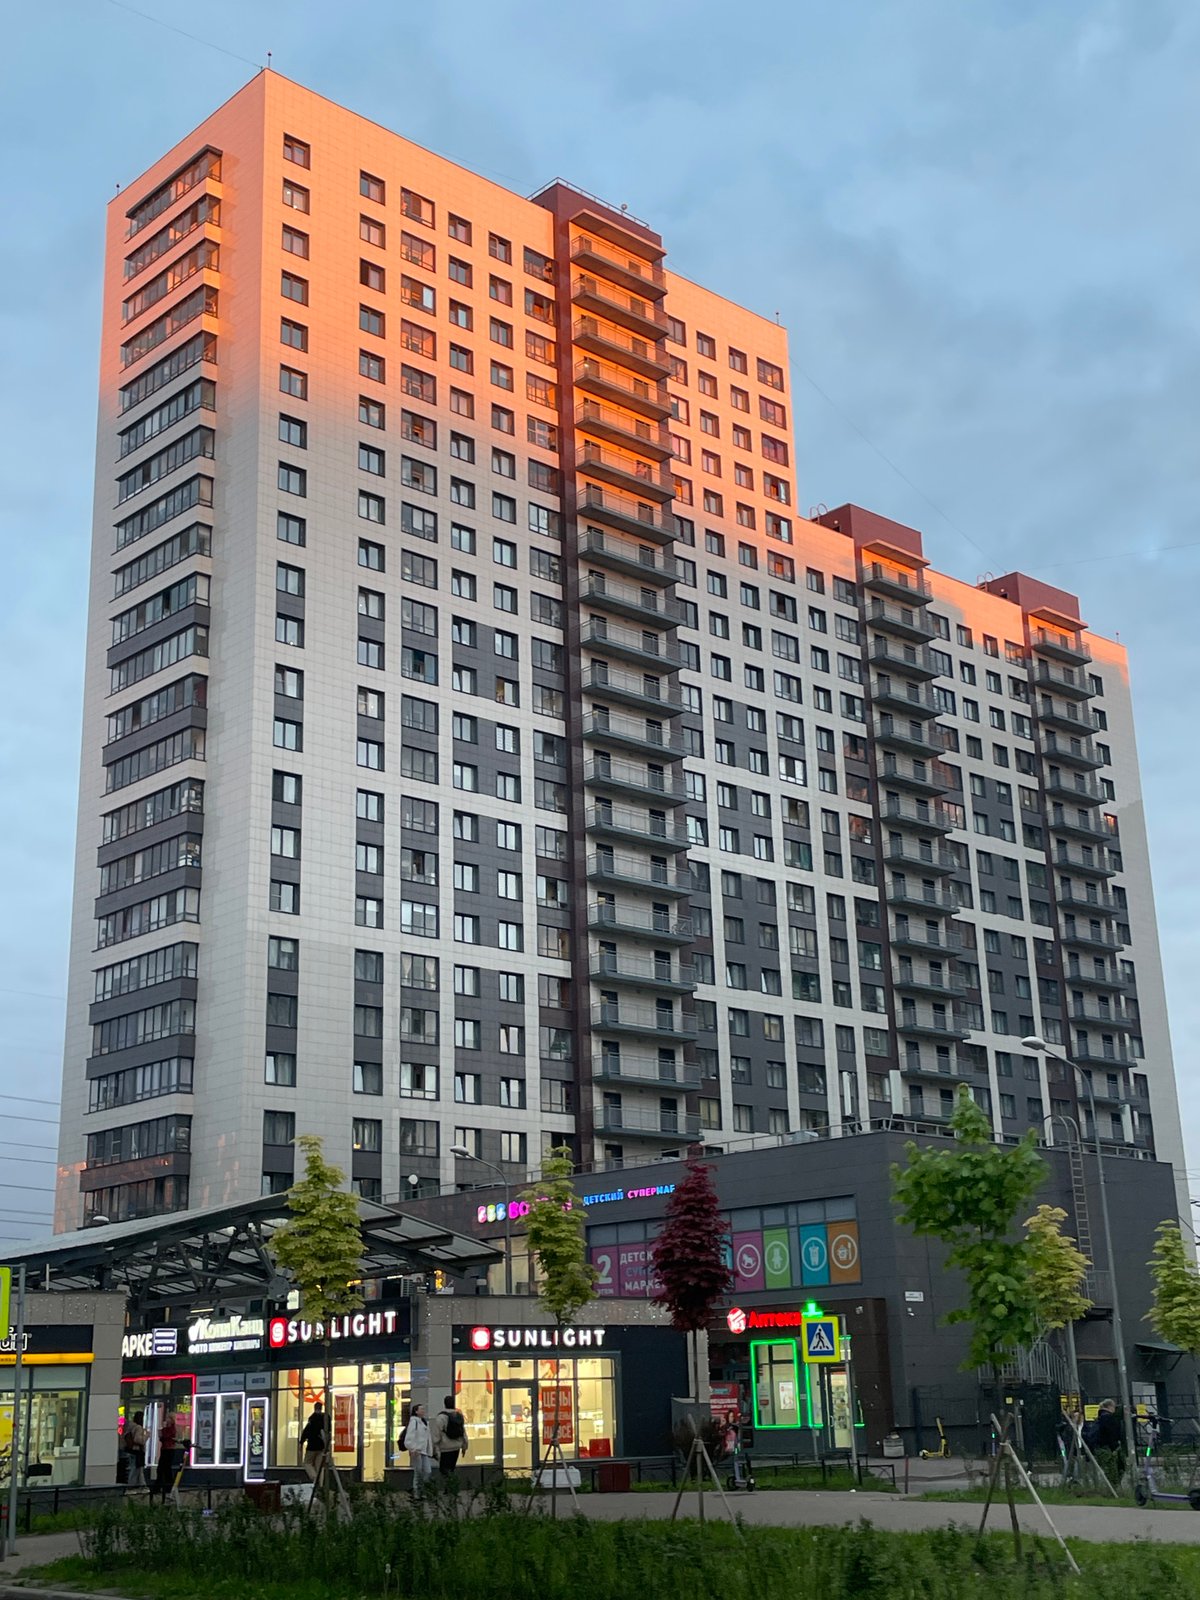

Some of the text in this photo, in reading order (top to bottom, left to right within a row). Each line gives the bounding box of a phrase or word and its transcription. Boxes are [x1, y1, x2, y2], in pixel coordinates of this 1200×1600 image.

[583, 1184, 676, 1206] ДЕТСКИЙ СУПЕРМАР
[620, 1251, 654, 1265] ДЕТСК
[597, 1254, 613, 1284] 2
[748, 1311, 802, 1328] Аптека
[493, 1329, 605, 1346] SUNLIGHT
